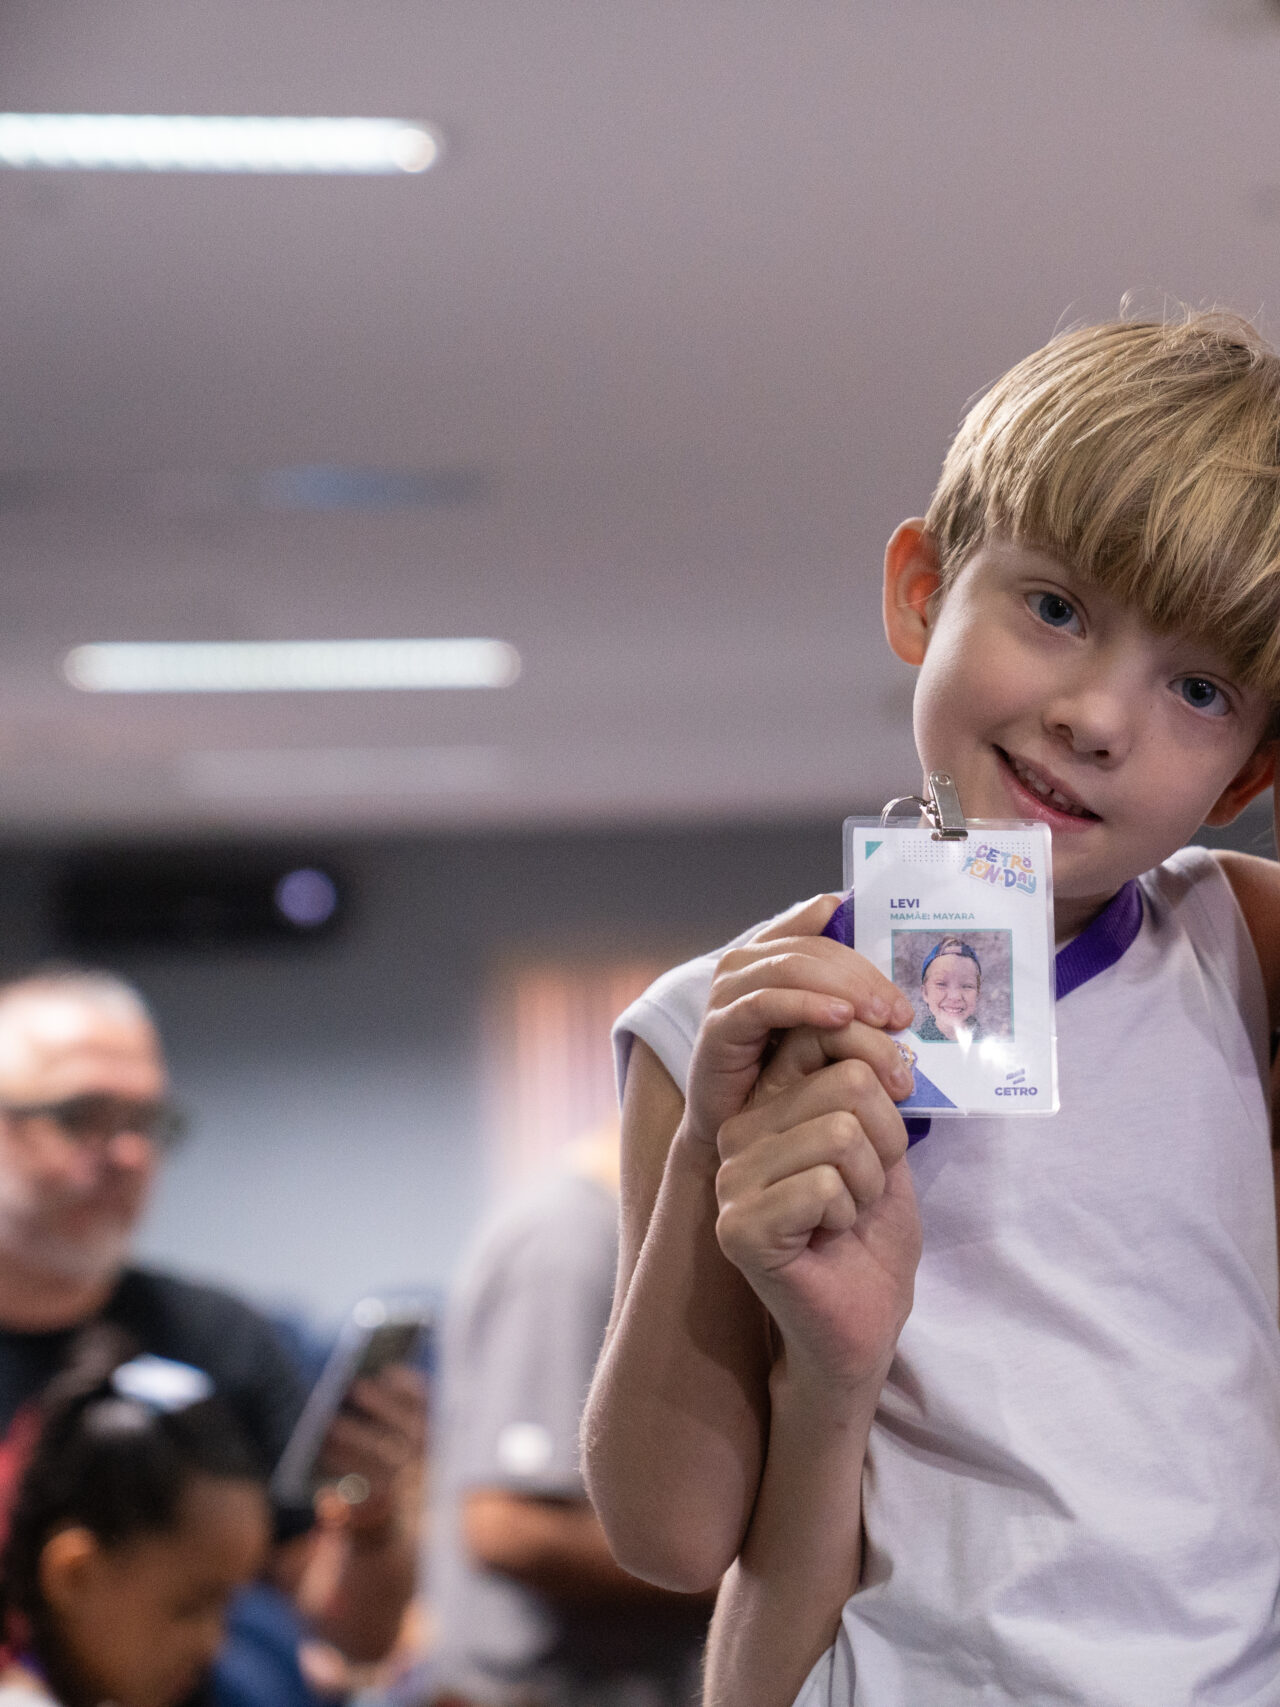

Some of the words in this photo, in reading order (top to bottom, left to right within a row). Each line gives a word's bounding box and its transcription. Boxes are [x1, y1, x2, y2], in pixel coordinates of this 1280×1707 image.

[976, 845, 1034, 873] CETRO
[890, 898, 920, 909] LEVI
[933, 912, 975, 920] MAYARA
[994, 1086, 1038, 1096] CETRO
